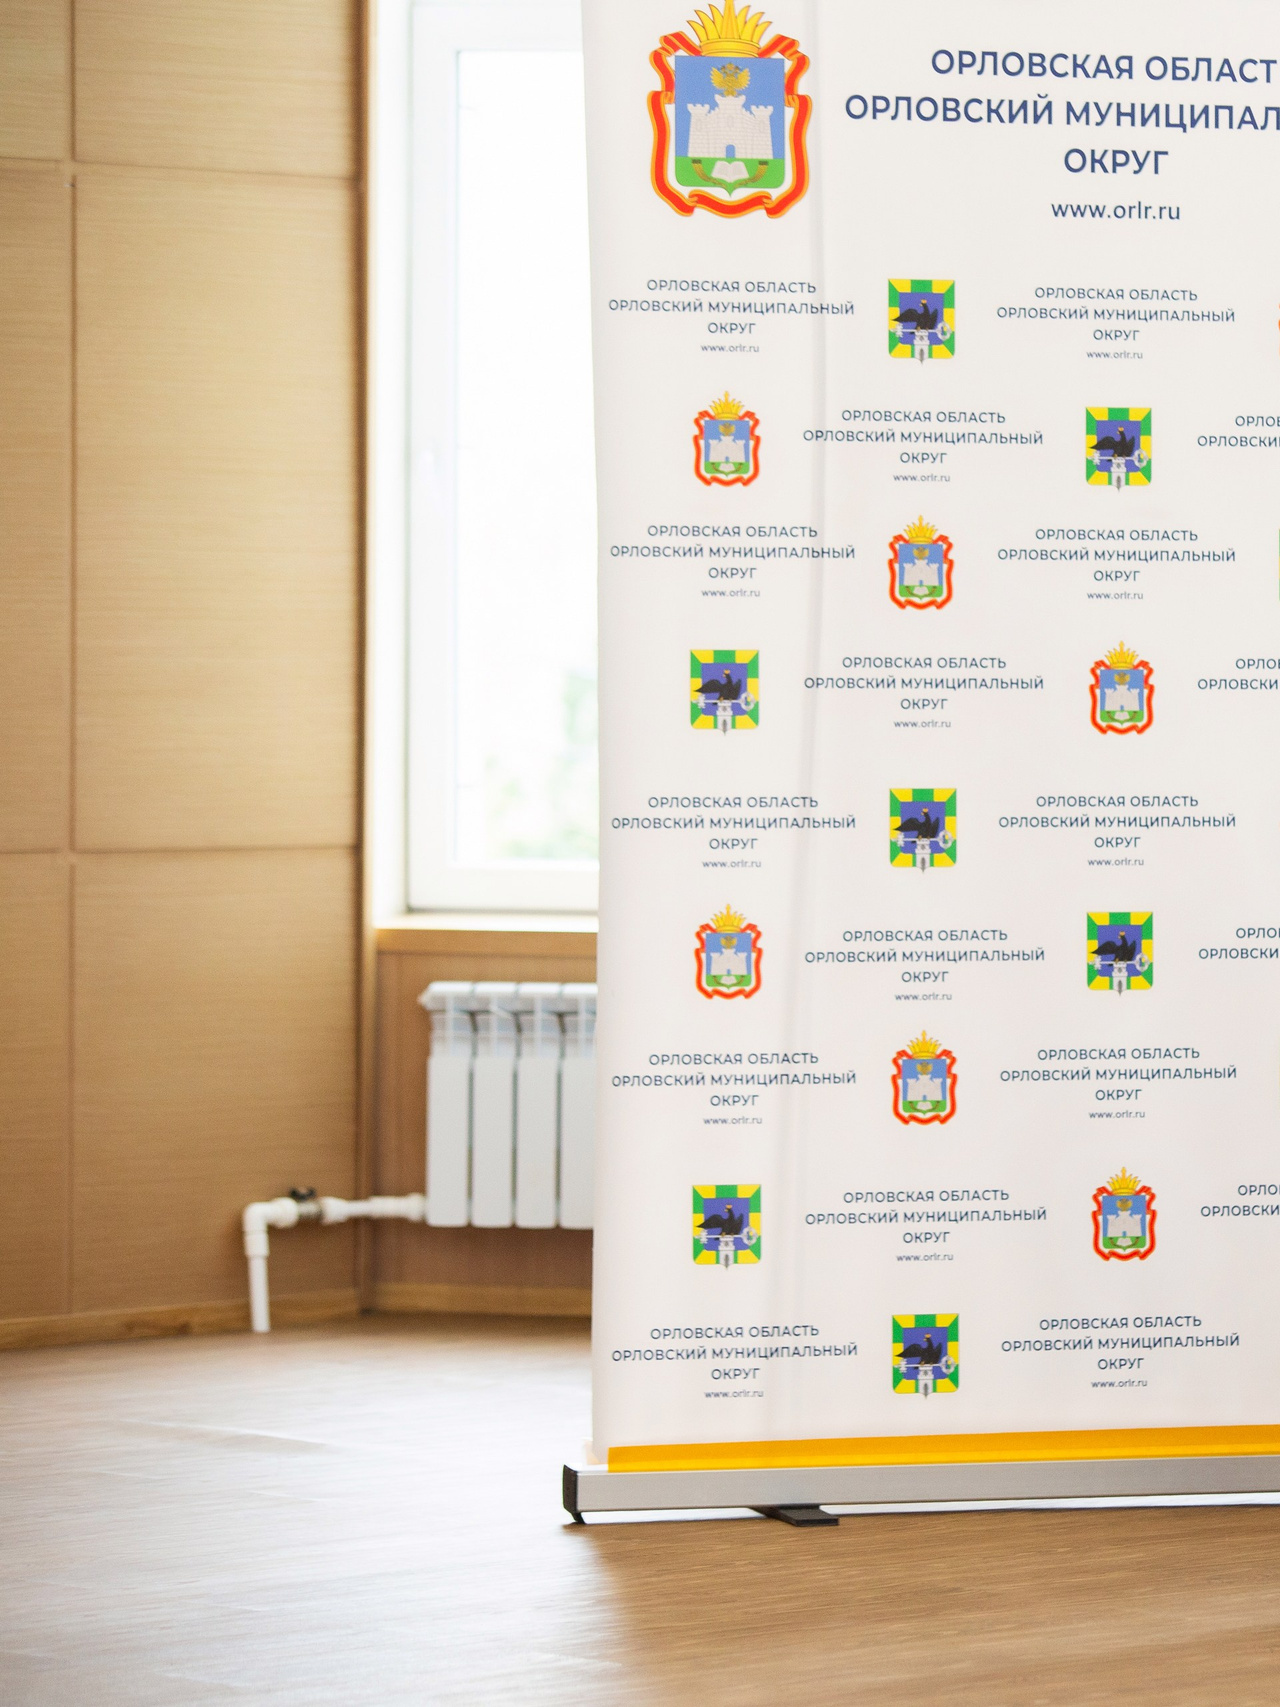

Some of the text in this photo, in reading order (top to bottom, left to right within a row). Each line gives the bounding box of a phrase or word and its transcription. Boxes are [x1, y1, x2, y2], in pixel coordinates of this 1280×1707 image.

[931, 49, 1134, 79] ОРЛОВСКАЯ
[845, 94, 1053, 125] ОРЛОВСКИЙ
[1063, 148, 1169, 175] ОКРУГ
[1051, 201, 1181, 220] www.orlr.ru
[647, 280, 816, 293] ОРЛОВСКАЯ ОБЛАСТЬ
[1035, 287, 1197, 301] ОРЛОВСКАЯ ОБЛАСТЬ
[609, 299, 854, 315] ОРЛОВСКИЙ МУНИЦИПАЛЬНЫЙ
[997, 306, 1234, 322] ОРЛОВСКИЙ МУНИЦИПАЛЬНЫЙ
[708, 322, 756, 334] ОКРУГ
[1093, 329, 1139, 340] ОКРУГ
[701, 344, 759, 352] www.orlr.ru
[1087, 351, 1143, 359] www.orlr.ru
[842, 410, 1005, 423] ОРЛОВСКАЯ ОБЛАСТЬ
[803, 429, 1043, 445] ОРЛОВСКИЙ МУНИЦИПАЛЬНЫЙ
[900, 452, 947, 463] ОКРУГ
[893, 474, 950, 482] www.orlr.ru
[648, 525, 818, 537] ОРЛОВСКАЯ ОБЛАСТЬ
[1036, 529, 1198, 541] ОРЛОВСКАЯ ОБЛАСТЬ
[610, 544, 855, 560] ОРЛОВСКИЙ МУНИЦИПАЛЬНЫЙ
[998, 547, 1235, 563] ОРЛОВСКИЙ МУНИЦИПАЛЬНЫЙ
[708, 567, 756, 579] ОКРУГ
[1094, 570, 1140, 581] ОКРУГ
[701, 589, 760, 597] www.orlr.ru
[842, 657, 1006, 668] ОРЛОВСКАЯ ОБЛАСТЬ
[804, 675, 1043, 691] ОРЛОВСКИЙ МУНИЦИПАЛЬНЫЙ
[900, 699, 948, 709] ОКРУГ
[894, 720, 951, 728] www.orlr.ru
[648, 797, 818, 808] ОРЛОВСКАЯ ОБЛАСТЬ
[1036, 796, 1198, 807] ОРЛОВСКАЯ ОБЛАСТЬ
[612, 815, 855, 830] ОРЛОВСКИЙ МУНИЦИПАЛЬНЫЙ
[999, 814, 1235, 829] ОРЛОВСКИЙ МУНИЦИПАЛЬНЫЙ
[709, 838, 758, 849] ОКРУГ
[1094, 837, 1140, 848] ОКРУГ
[702, 860, 761, 868] www.orlr.ru
[1088, 858, 1144, 866] www.orlr.ru
[843, 930, 1008, 942] ОРЛОВСКАЯ ОБЛАСТЬ
[805, 947, 1044, 963] ОРЛОВСКИЙ МУНИЦИПАЛЬНЫЙ
[902, 971, 949, 982] ОКРУГ
[895, 992, 952, 1001] www.orlr.ru
[649, 1053, 818, 1065] ОРЛОВСКАЯ ОБЛАСТЬ
[1038, 1048, 1200, 1060] ОРЛОВСКАЯ ОБЛАСТЬ
[612, 1071, 856, 1087] ОРЛОВСКИЙ МУНИЦИПАЛЬНЫЙ
[1000, 1065, 1236, 1081] ОРЛОВСКИЙ МУНИЦИПАЛЬНЫЙ
[710, 1095, 759, 1106] ОКРУГ
[1095, 1089, 1142, 1101] ОКРУГ
[703, 1116, 762, 1124] www.orlr.ru
[1089, 1110, 1145, 1118] www.orlr.ru
[843, 1190, 1009, 1203] ОРЛОВСКАЯ ОБЛАСТЬ
[805, 1207, 1046, 1225] ОРЛОВСКИЙ МУНИЦИПАЛЬНЫЙ
[903, 1232, 950, 1243] ОКРУГ
[896, 1253, 953, 1261] www.orlr.ru
[1040, 1316, 1201, 1330] ОРЛОВСКАЯ ОБЛАСТЬ
[650, 1325, 819, 1339] ОРЛОВСКАЯ ОБЛАСТЬ
[1002, 1333, 1239, 1352] ОРЛОВСКИЙ МУНИЦИПАЛЬНЫЙ
[612, 1342, 857, 1361] ОРЛОВСКИЙ МУНИЦИПАЛЬНЫЙ
[1098, 1358, 1144, 1370] ОКРУГ
[711, 1368, 760, 1380] ОКРУГ
[1091, 1379, 1147, 1388] www.orlr.ru
[705, 1390, 763, 1398] www.orlr.ru
